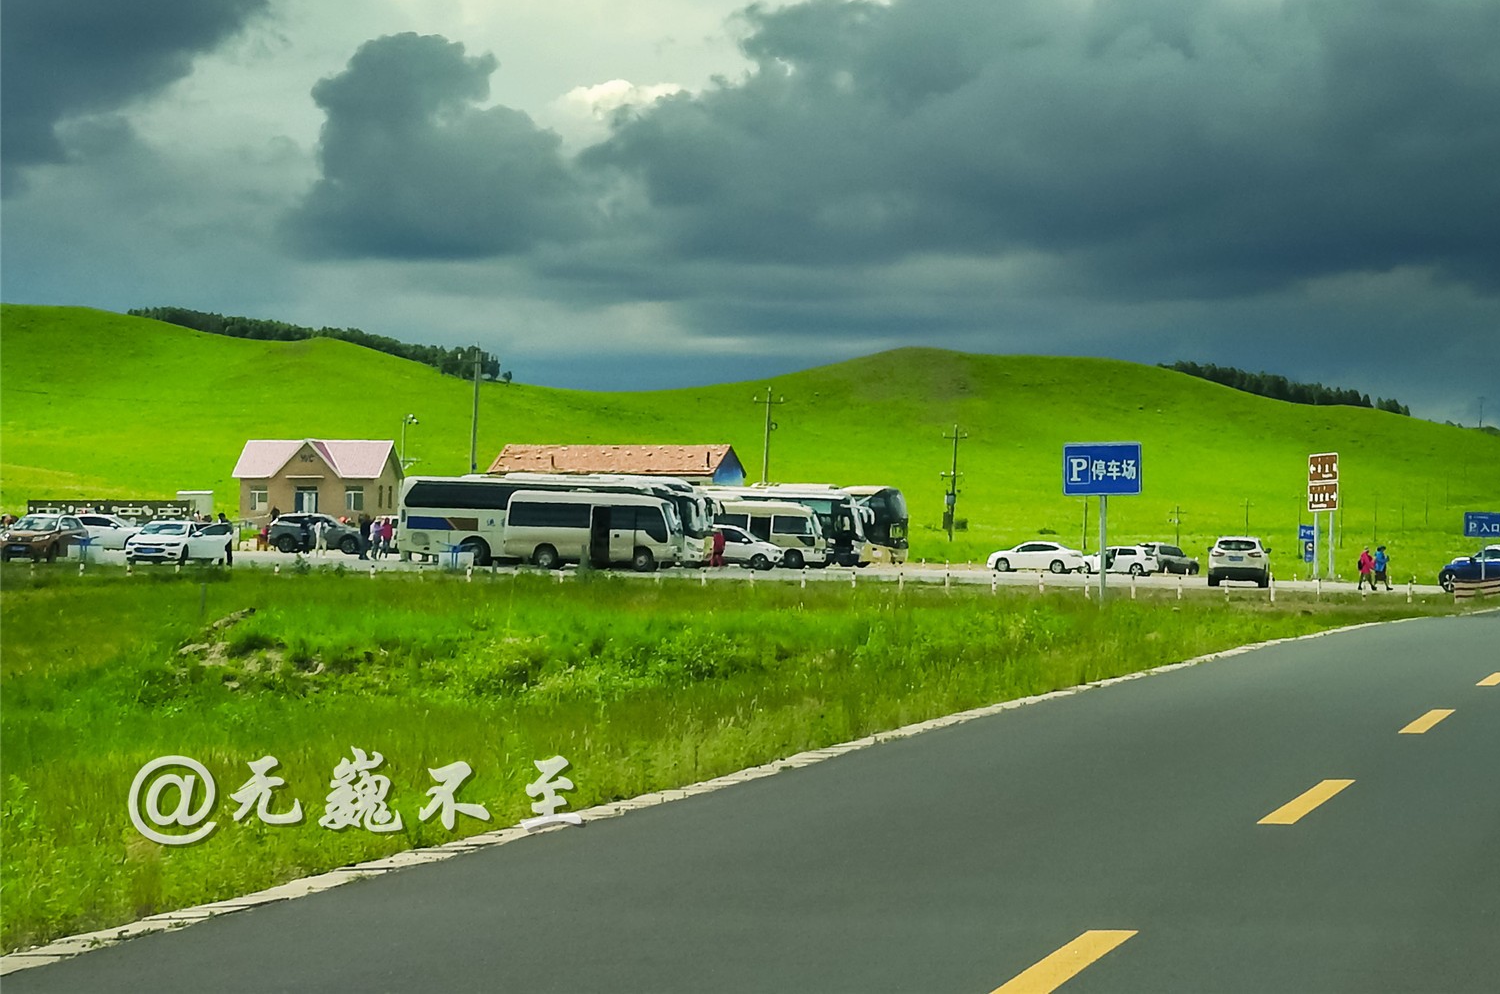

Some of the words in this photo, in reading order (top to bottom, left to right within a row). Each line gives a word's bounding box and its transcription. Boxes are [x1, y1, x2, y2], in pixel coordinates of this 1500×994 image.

[1070, 458, 1088, 482] P
[1091, 459, 1137, 481] 停车场
[1480, 522, 1500, 533] 入口
